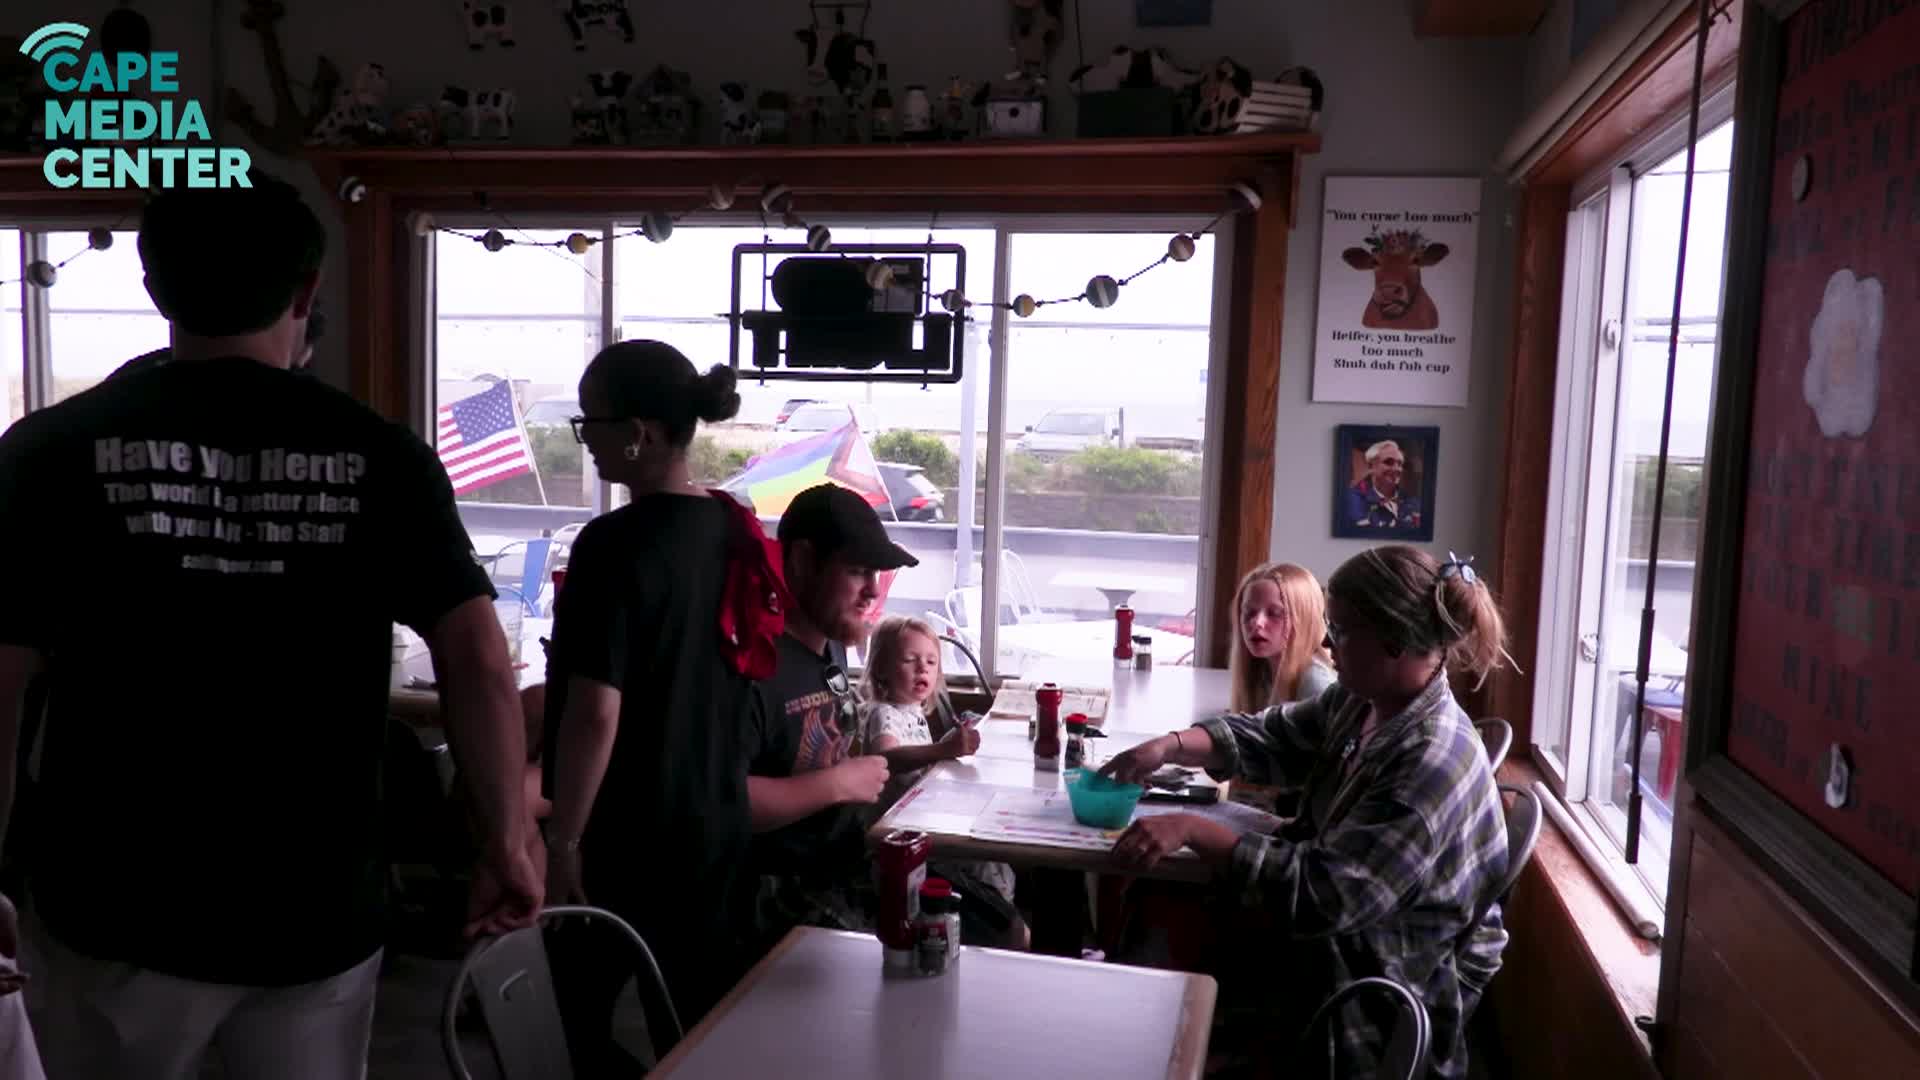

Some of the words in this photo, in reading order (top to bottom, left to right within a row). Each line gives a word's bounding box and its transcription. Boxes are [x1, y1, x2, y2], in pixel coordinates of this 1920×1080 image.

[1361, 211, 1400, 222] curse
[1405, 210, 1428, 222] too
[1378, 333, 1400, 344] you
[1404, 333, 1456, 345] breathe
[1361, 345, 1383, 357] too
[1387, 346, 1423, 357] much
[1334, 358, 1366, 369] Shuh
[1370, 360, 1395, 371] duh
[1399, 360, 1421, 372] fuh
[1426, 362, 1450, 374] cup
[95, 437, 192, 473] Have
[259, 448, 365, 484] Herd?
[104, 483, 147, 504] The
[305, 492, 360, 513] place
[256, 522, 292, 543] The
[298, 521, 346, 543] Staff
